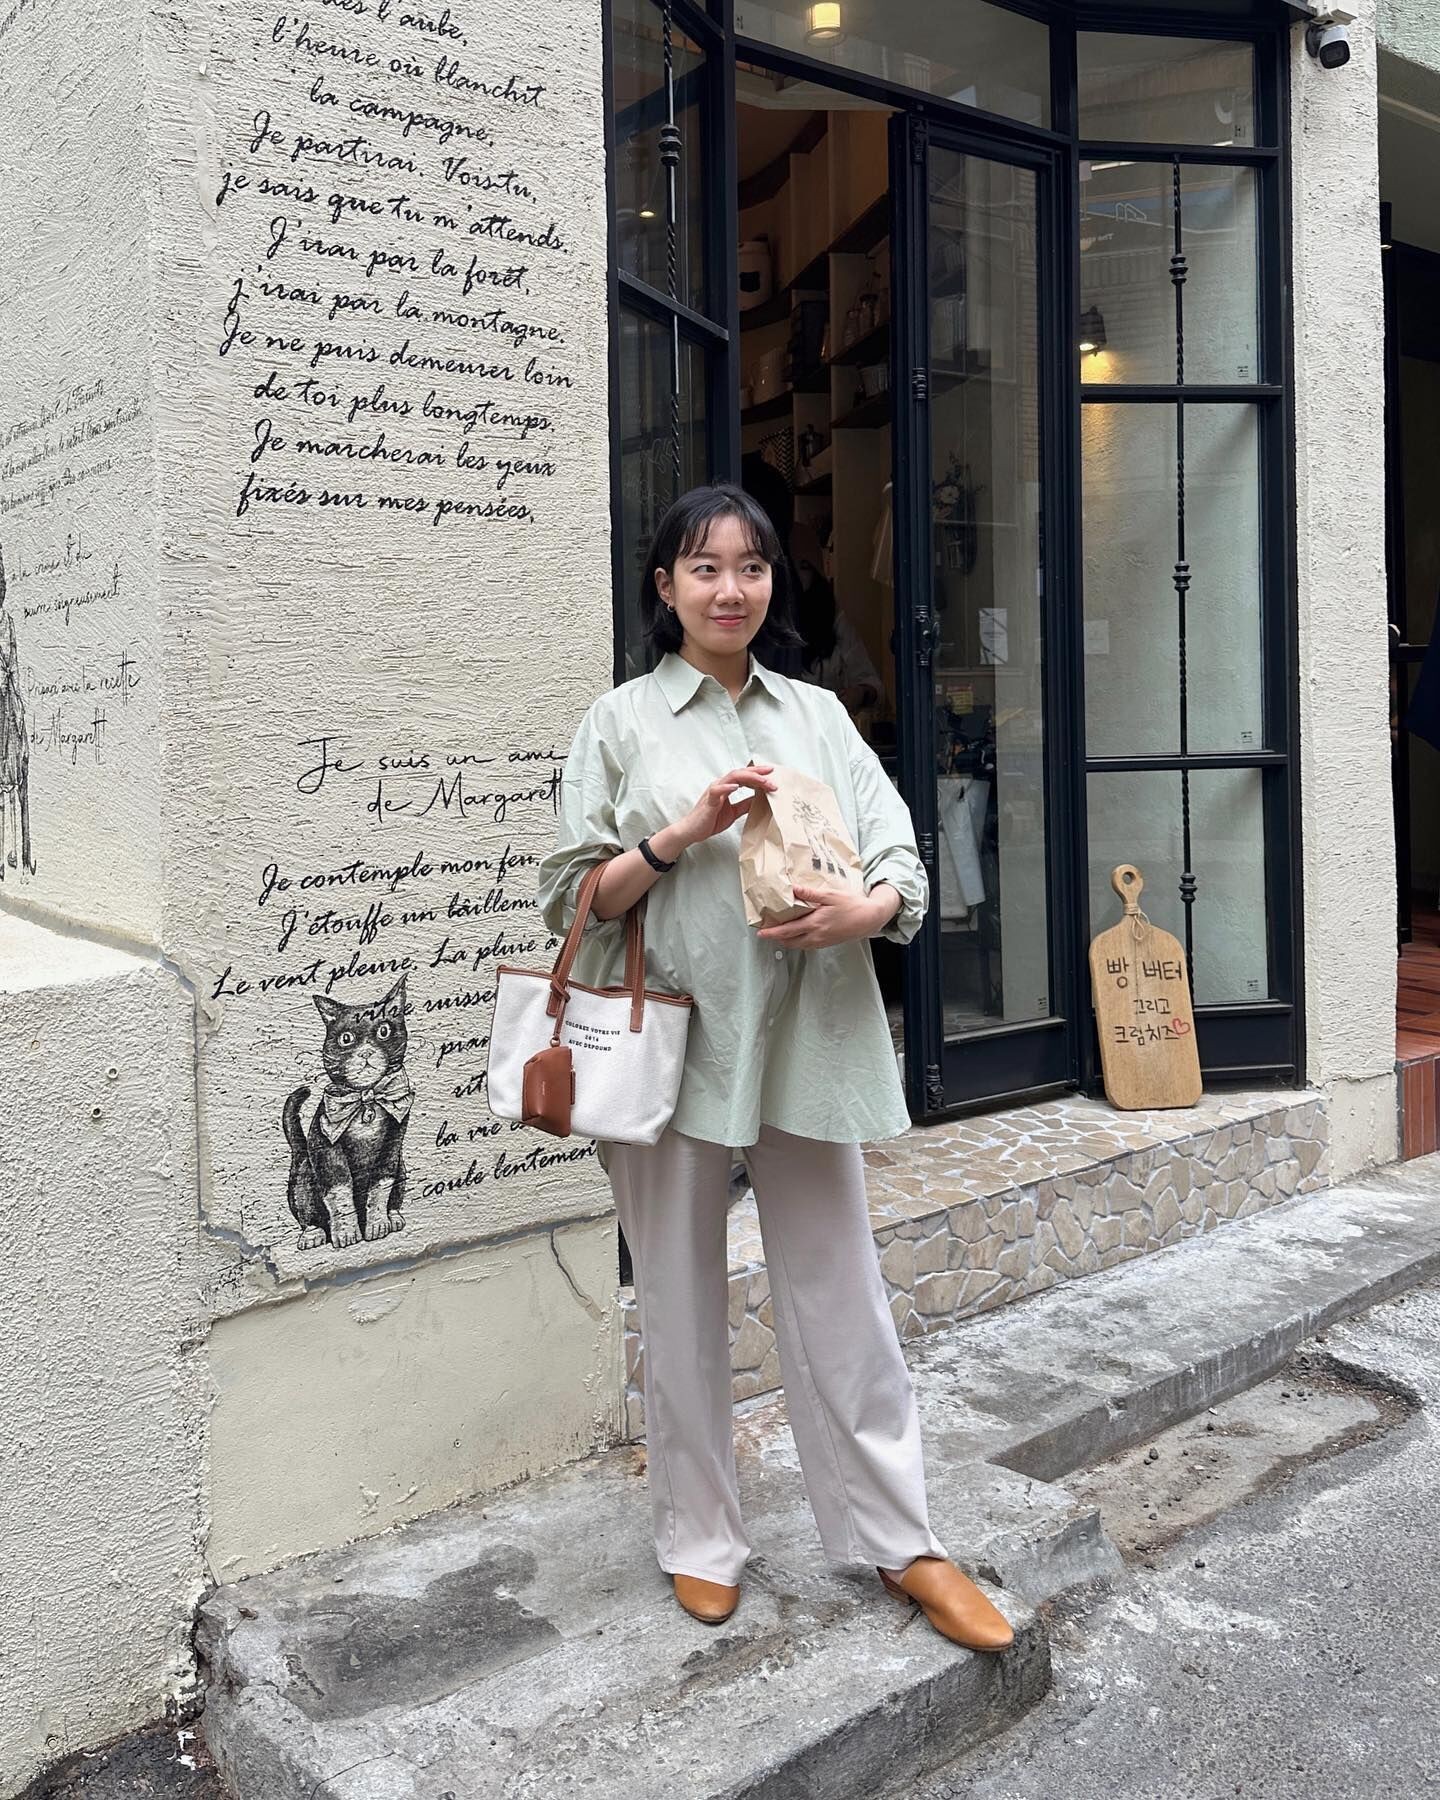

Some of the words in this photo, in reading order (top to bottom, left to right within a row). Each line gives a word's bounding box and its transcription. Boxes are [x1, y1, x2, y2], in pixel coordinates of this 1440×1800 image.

[272, 16, 380, 66] l'heure
[390, 56, 424, 77] où
[435, 56, 545, 106] blanchit
[310, 77, 339, 105] la
[350, 98, 494, 147] campagne,
[250, 110, 284, 153] Je
[291, 134, 424, 177] partirai.
[216, 163, 249, 206] je
[259, 177, 320, 202] sais
[328, 192, 384, 222] que
[388, 196, 425, 223] tu
[433, 204, 568, 253] m'attends.
[266, 216, 359, 259] J'irai
[367, 248, 419, 277] par
[432, 247, 457, 277] la
[329, 294, 383, 320] par
[396, 290, 421, 319] la
[433, 311, 565, 347] montagne.
[219, 312, 255, 356] Je
[265, 334, 304, 352] ne
[311, 338, 380, 368] puis
[390, 341, 514, 379] demeurer
[525, 359, 573, 389] loin
[254, 371, 288, 401] de
[294, 378, 340, 407] toi
[348, 384, 414, 422] plus
[423, 390, 555, 439] longtemps.
[251, 418, 285, 462] Je
[297, 434, 446, 466] marcherai
[456, 442, 488, 472] les
[496, 458, 556, 489] yeux
[236, 472, 312, 517] fixés
[318, 488, 367, 510] sur
[377, 494, 430, 513] mes
[296, 736, 365, 794] Je
[379, 751, 430, 771] suis
[447, 754, 495, 766] un
[508, 744, 569, 764] ami
[367, 775, 413, 823] de
[258, 863, 291, 906] Je
[300, 851, 433, 891] contemple
[440, 858, 493, 876] mon
[277, 902, 393, 952] J'étouffe
[401, 908, 437, 924] un
[211, 967, 252, 999] Le
[259, 960, 327, 989] vent
[429, 937, 468, 968] La
[473, 931, 537, 971] pluie
[1106, 957, 1130, 989] 빵
[1142, 960, 1182, 981] 버터
[353, 1001, 414, 1024] vitre
[1133, 998, 1172, 1015] 그리고
[436, 1120, 459, 1147] la
[467, 1118, 501, 1141] vie
[422, 1160, 485, 1198] coule
